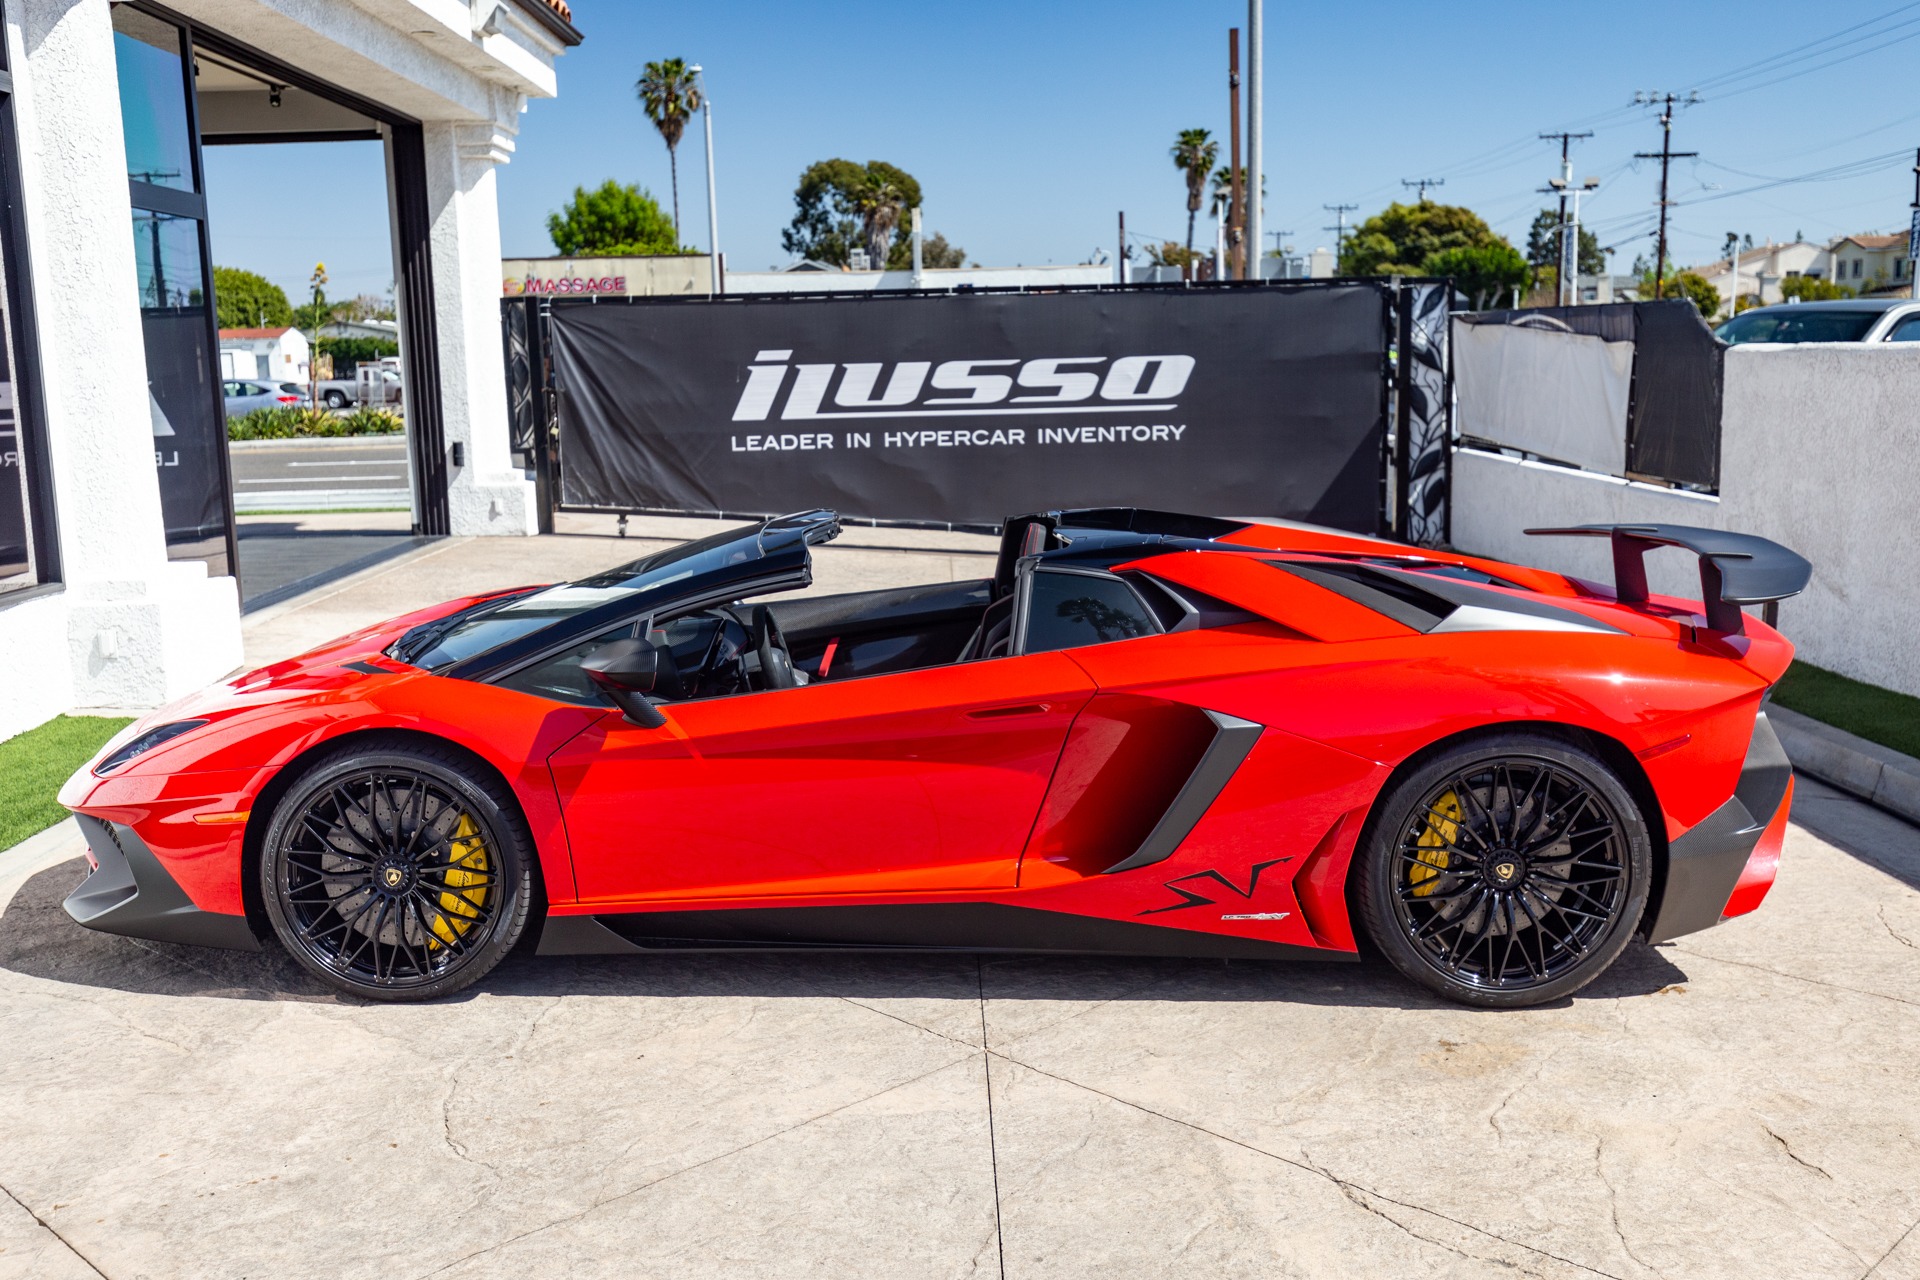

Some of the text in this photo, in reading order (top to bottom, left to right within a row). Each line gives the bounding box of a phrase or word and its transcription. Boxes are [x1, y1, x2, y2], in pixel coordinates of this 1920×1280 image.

[525, 276, 626, 294] MASSAGE
[731, 424, 1187, 452] LEADER IN HYPERCAR INVENTORY
